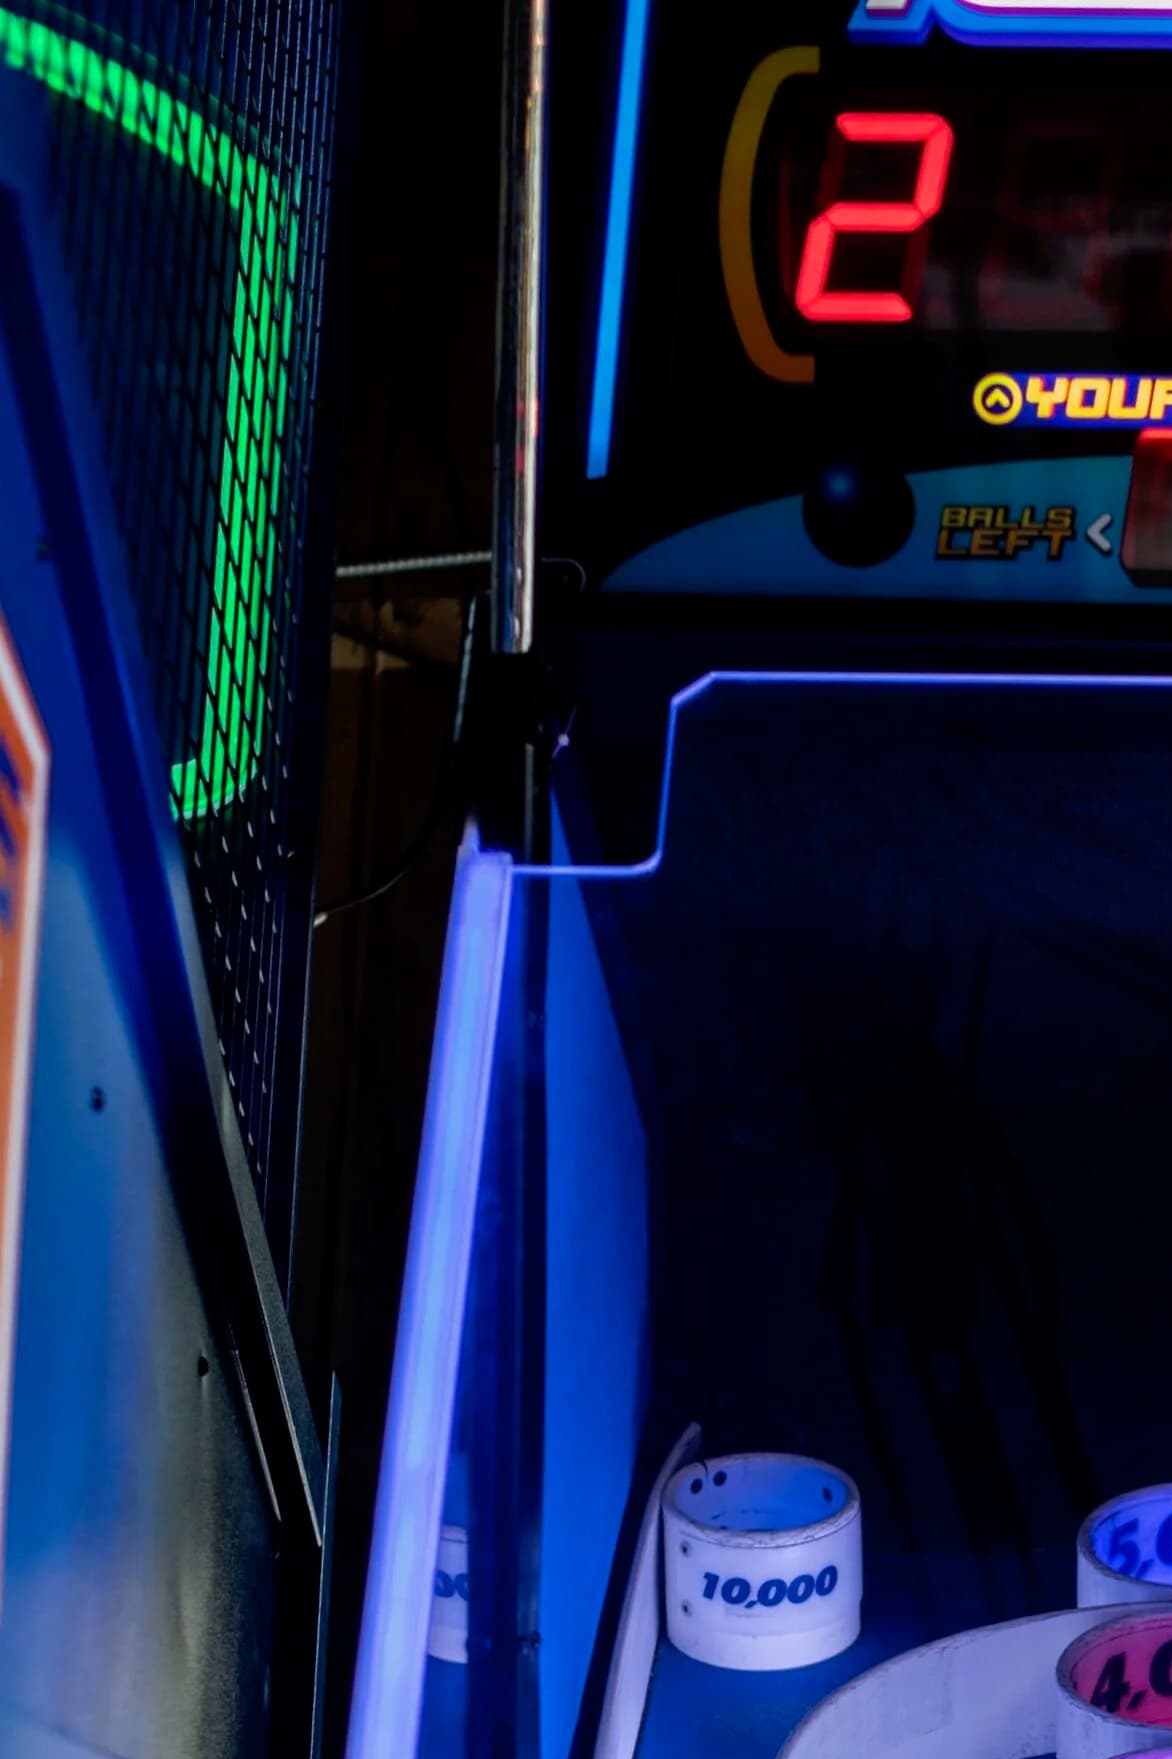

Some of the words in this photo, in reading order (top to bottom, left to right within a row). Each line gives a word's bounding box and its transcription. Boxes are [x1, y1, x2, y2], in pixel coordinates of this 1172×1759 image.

[796, 112, 954, 322] 2
[940, 505, 1074, 529] BALLS
[935, 527, 1073, 559] LEFT
[703, 1565, 838, 1608] 10,000
